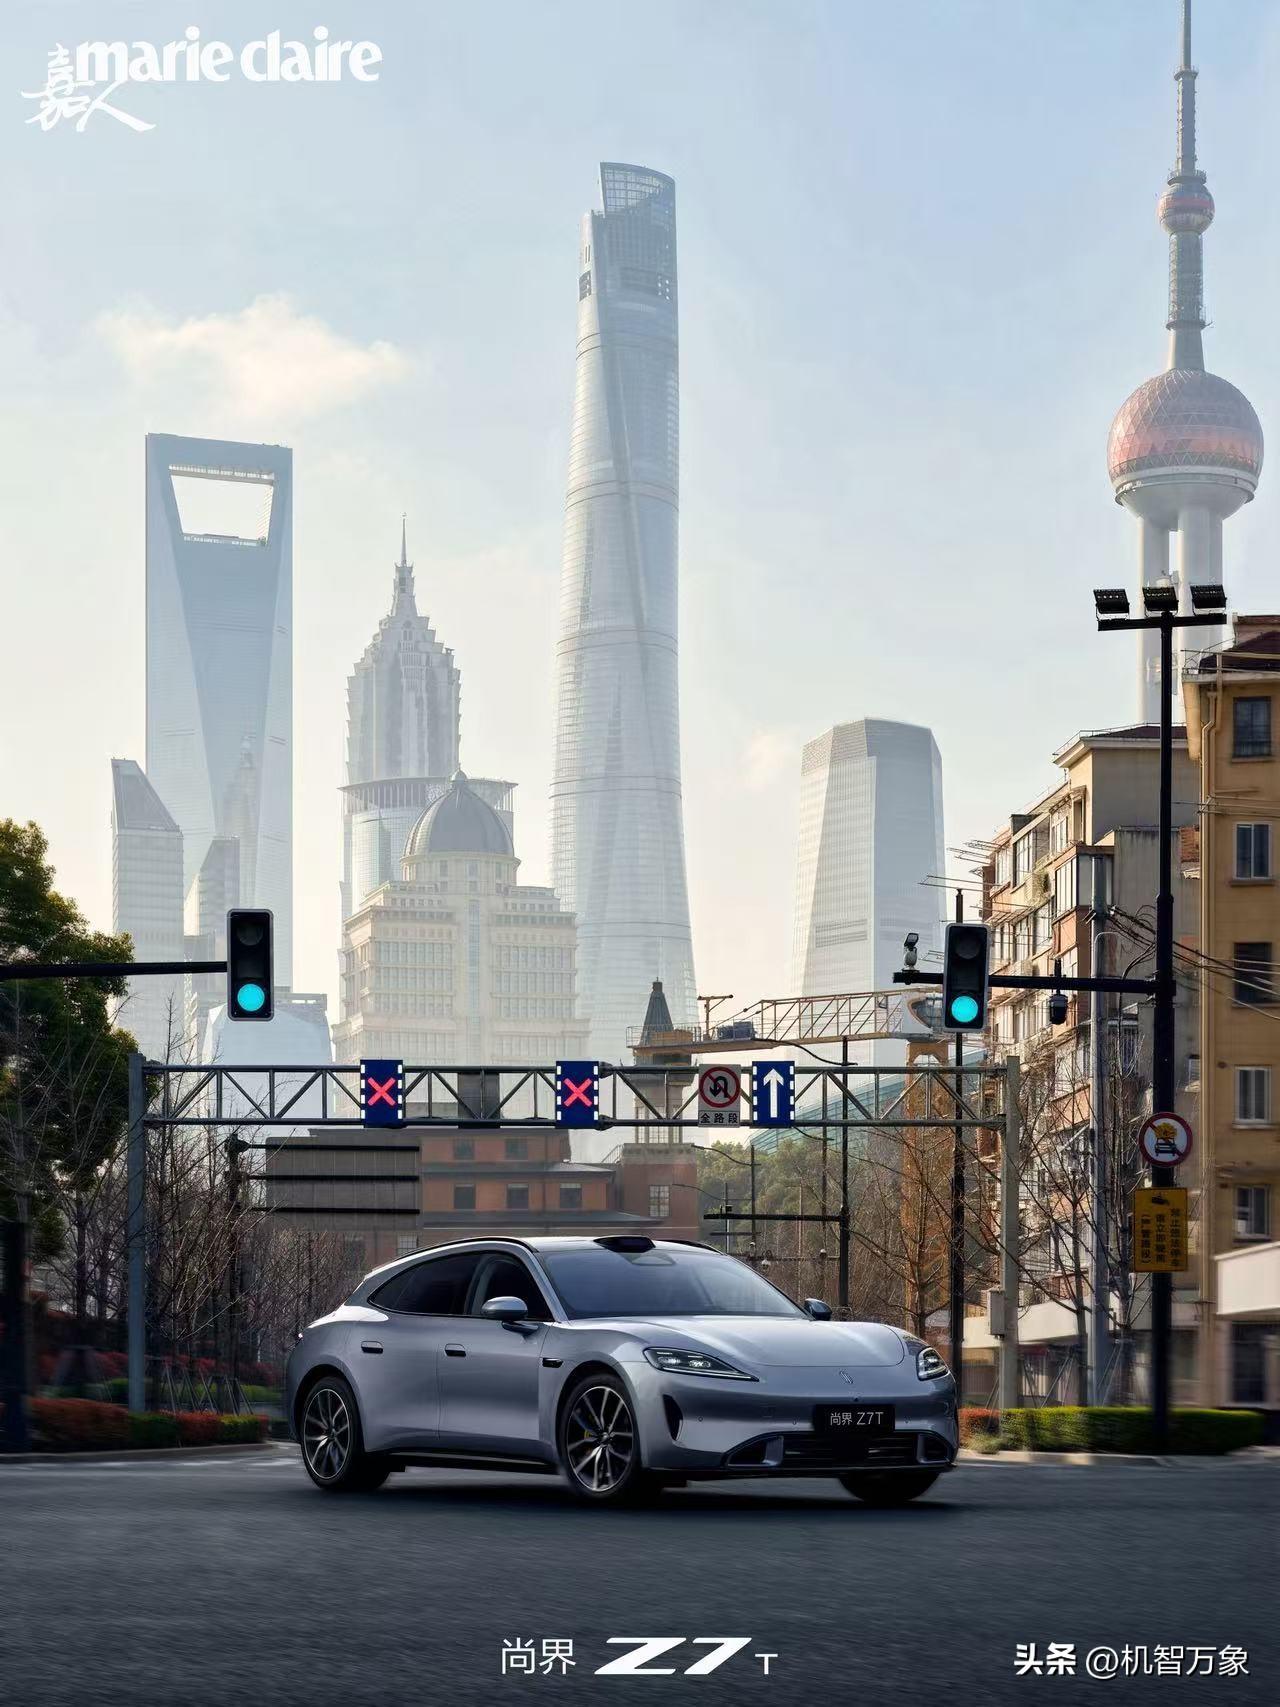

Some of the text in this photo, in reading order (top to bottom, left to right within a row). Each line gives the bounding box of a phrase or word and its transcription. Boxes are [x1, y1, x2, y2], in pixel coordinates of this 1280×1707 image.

[700, 1112, 738, 1124] 全路段
[830, 1411, 884, 1426] 尚界 Z7T
